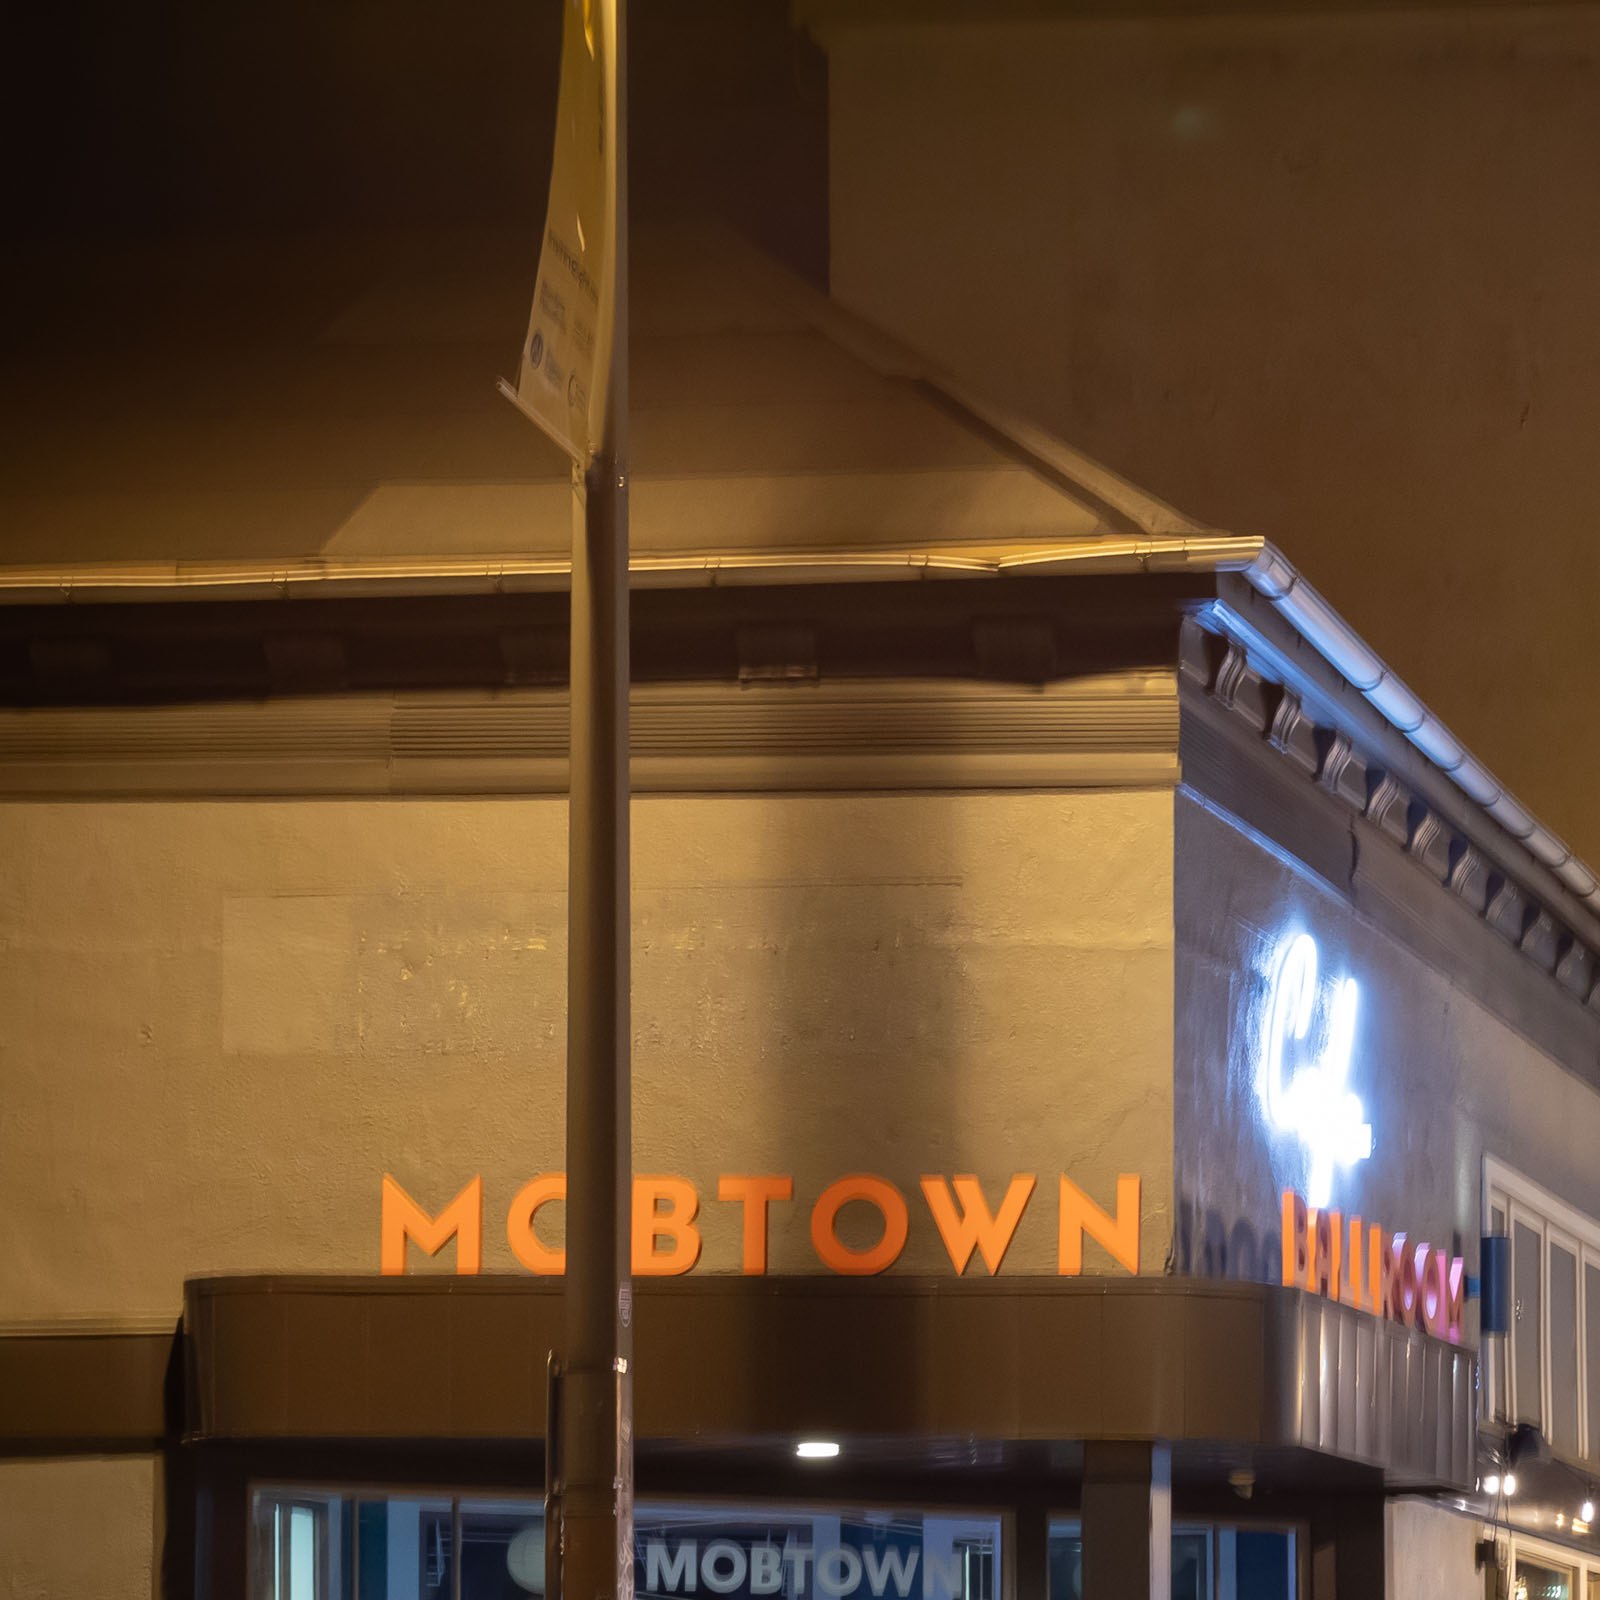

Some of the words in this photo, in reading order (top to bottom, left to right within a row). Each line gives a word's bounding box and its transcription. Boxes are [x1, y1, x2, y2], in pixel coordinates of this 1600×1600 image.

[380, 1172, 1143, 1276] MOBTOWN
[1280, 1187, 1465, 1345] BALLROOM
[645, 1537, 963, 1597] MOBTOWN
